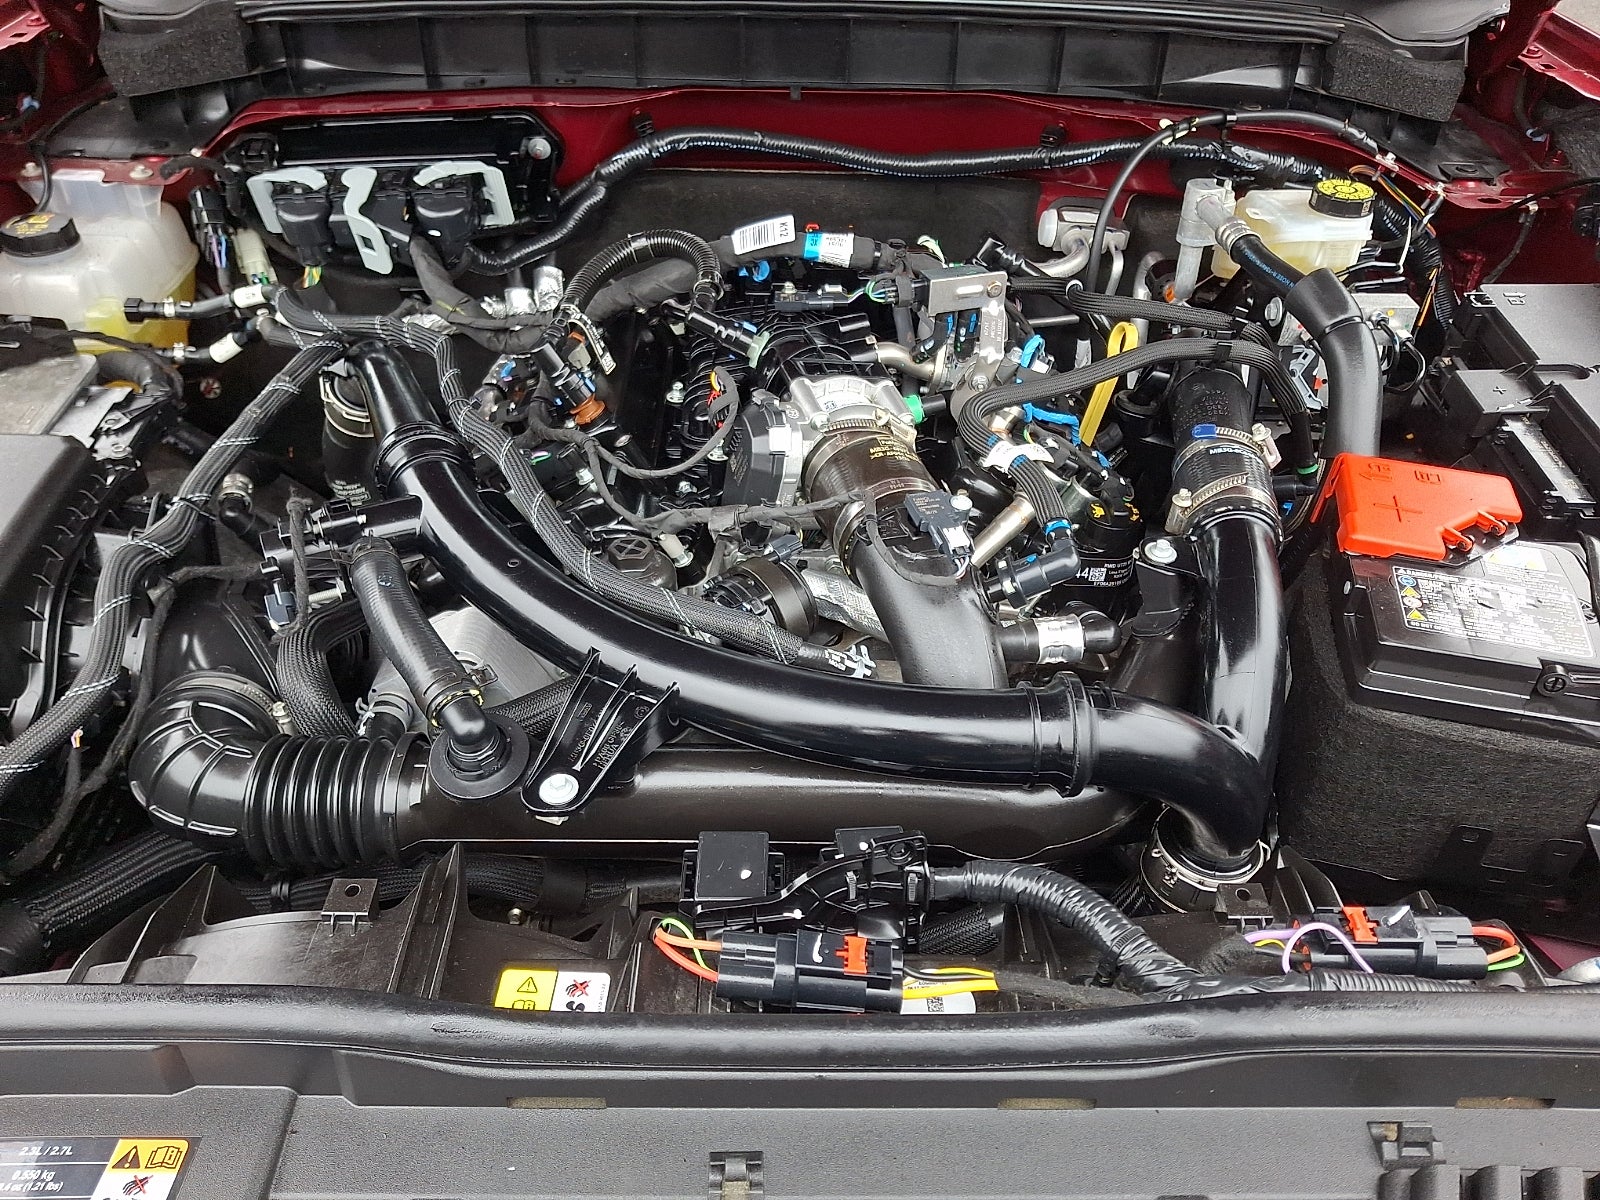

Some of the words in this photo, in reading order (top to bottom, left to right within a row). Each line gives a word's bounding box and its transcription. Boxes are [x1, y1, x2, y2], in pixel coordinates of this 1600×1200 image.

[18, 1146, 42, 1156] 2.3L
[50, 1145, 73, 1156] 2.7L
[40, 1169, 56, 1182] kg
[45, 1181, 64, 1192] lbs)
